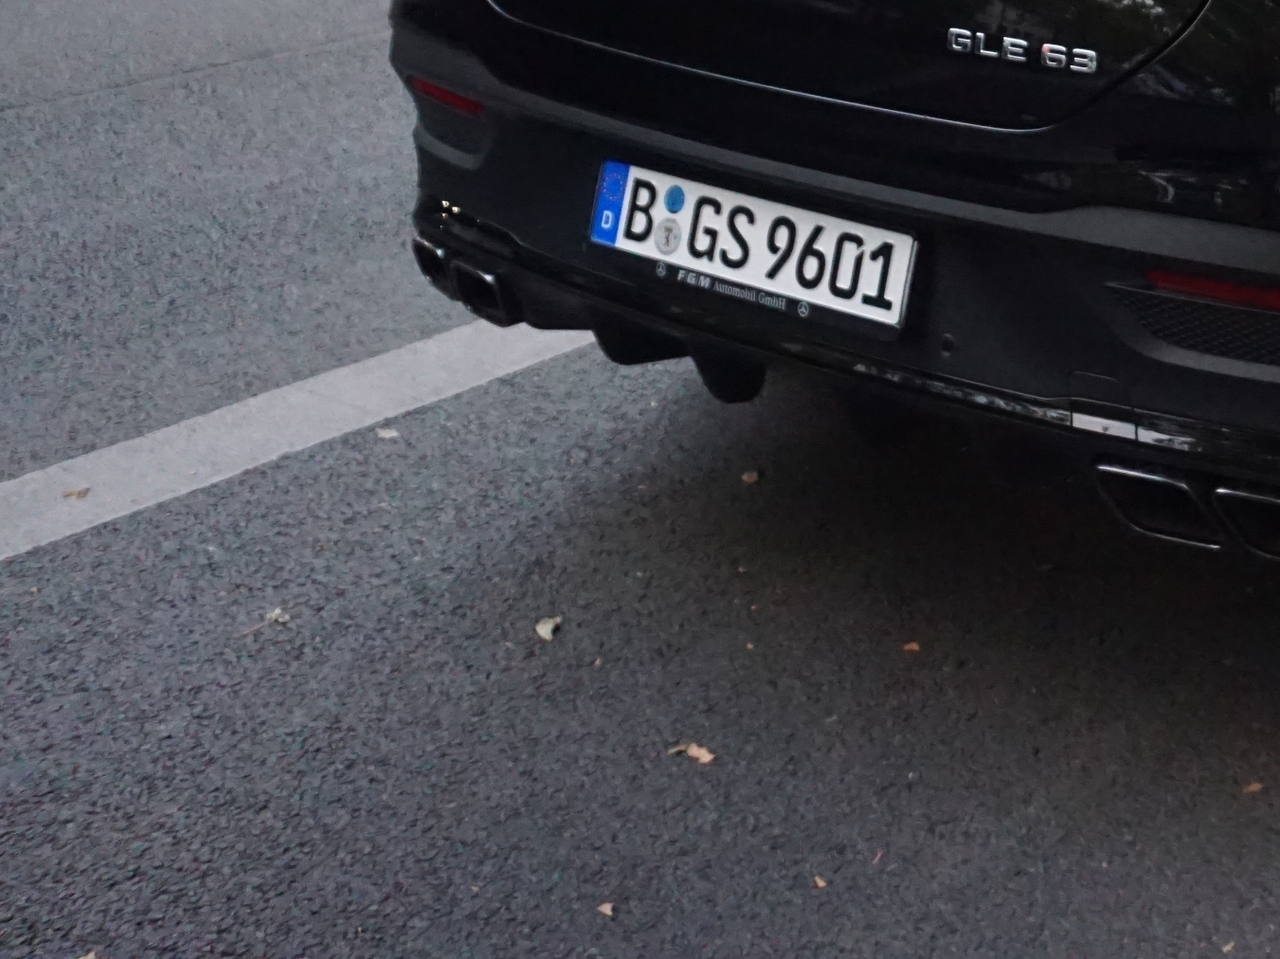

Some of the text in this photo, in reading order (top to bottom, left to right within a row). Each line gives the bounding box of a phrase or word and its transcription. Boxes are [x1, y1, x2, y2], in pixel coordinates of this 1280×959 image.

[948, 27, 1098, 74] GLE 63
[601, 210, 615, 229] D
[623, 176, 894, 312] B GS 9601
[713, 280, 756, 302] Automobil
[758, 292, 786, 311] GmbH
